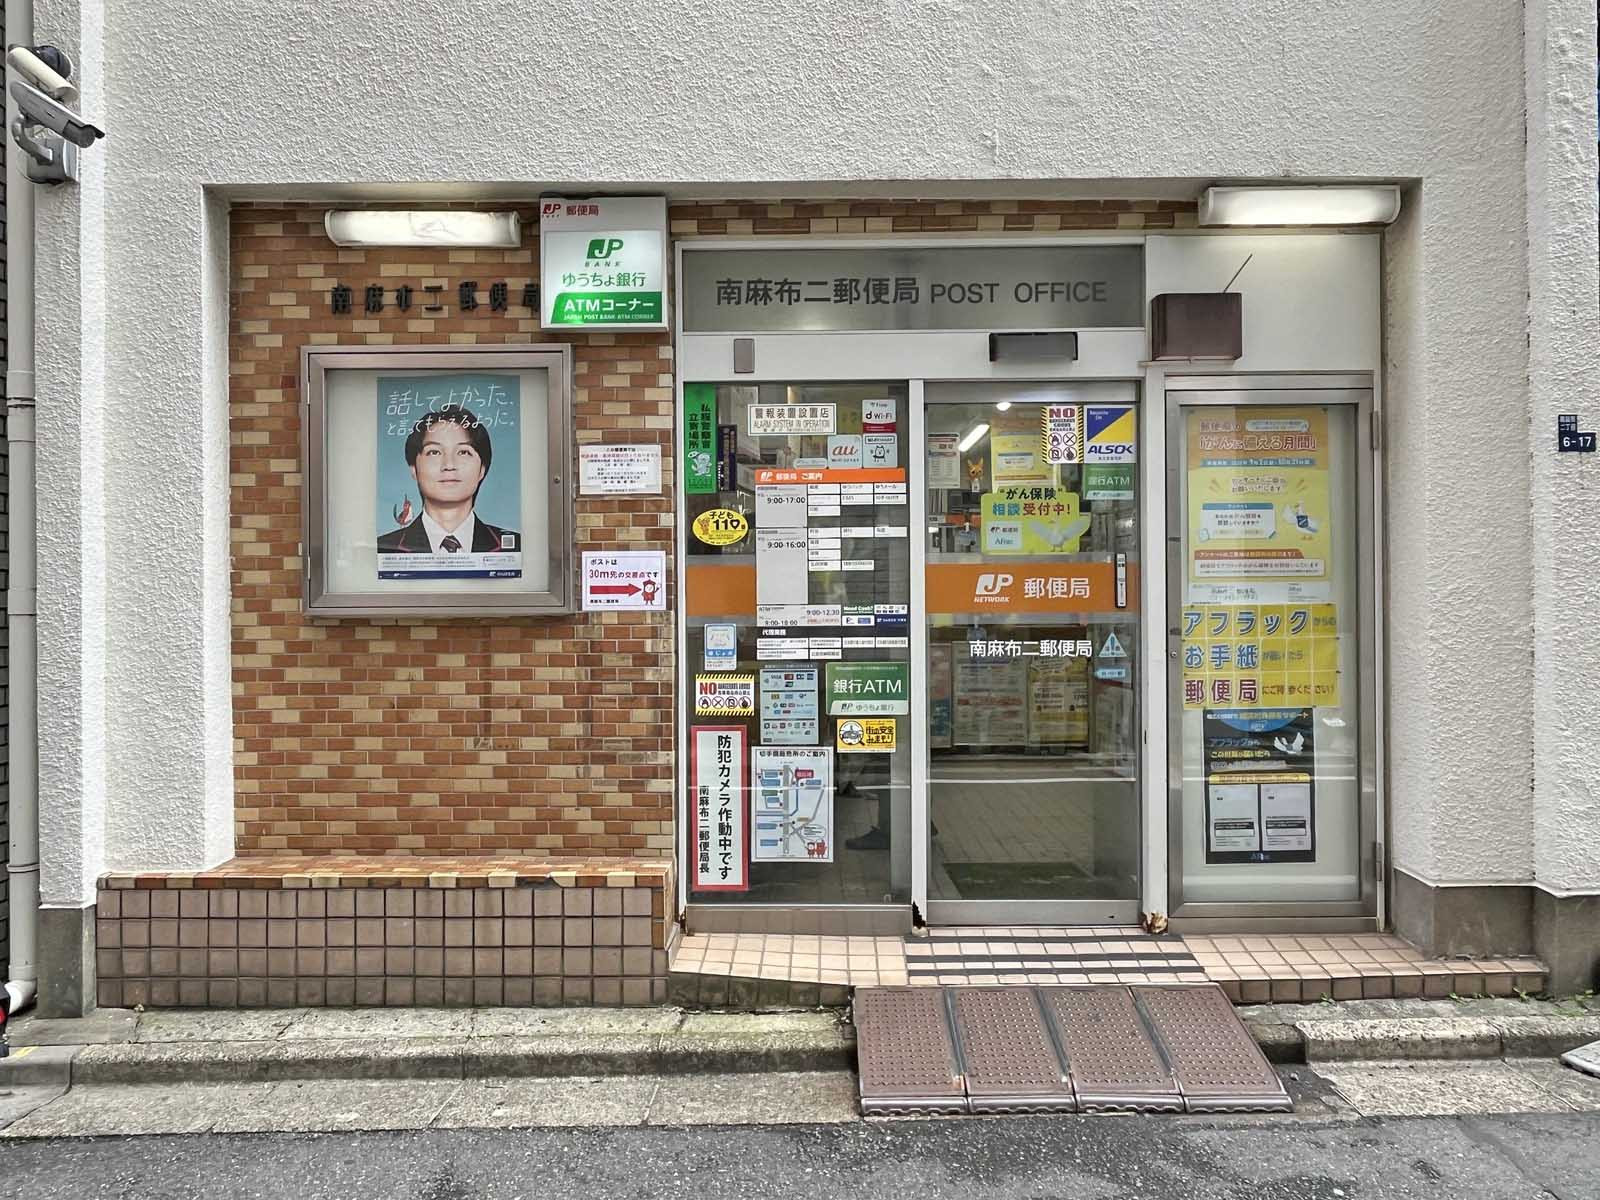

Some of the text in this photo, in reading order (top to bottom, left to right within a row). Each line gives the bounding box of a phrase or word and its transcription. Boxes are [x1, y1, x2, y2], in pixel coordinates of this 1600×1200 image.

[566, 205, 599, 216] 郵便局
[587, 239, 624, 259] JP
[562, 272, 646, 287] ゆうちょ銀行
[716, 277, 1107, 306] 南麻布二郵便局 POST OFFICE
[564, 299, 654, 311] ATMコーナー
[1049, 408, 1076, 418] NO
[1563, 436, 1592, 447] 6-17
[833, 446, 858, 455] au
[1088, 445, 1133, 454] ALSOK
[767, 496, 806, 504] 9:00-17:00
[709, 511, 734, 519] 子ども
[589, 569, 658, 578] 30m先の交差点です
[975, 574, 1013, 595] JP
[1024, 577, 1090, 598] 郵便局
[969, 640, 1092, 657] 南麻布二郵便局
[699, 682, 717, 695] NO
[833, 679, 902, 693] 銀行ATM
[718, 735, 732, 880] 防犯カメラ作動中です
[699, 785, 710, 873] 南麻布二郵便局長
